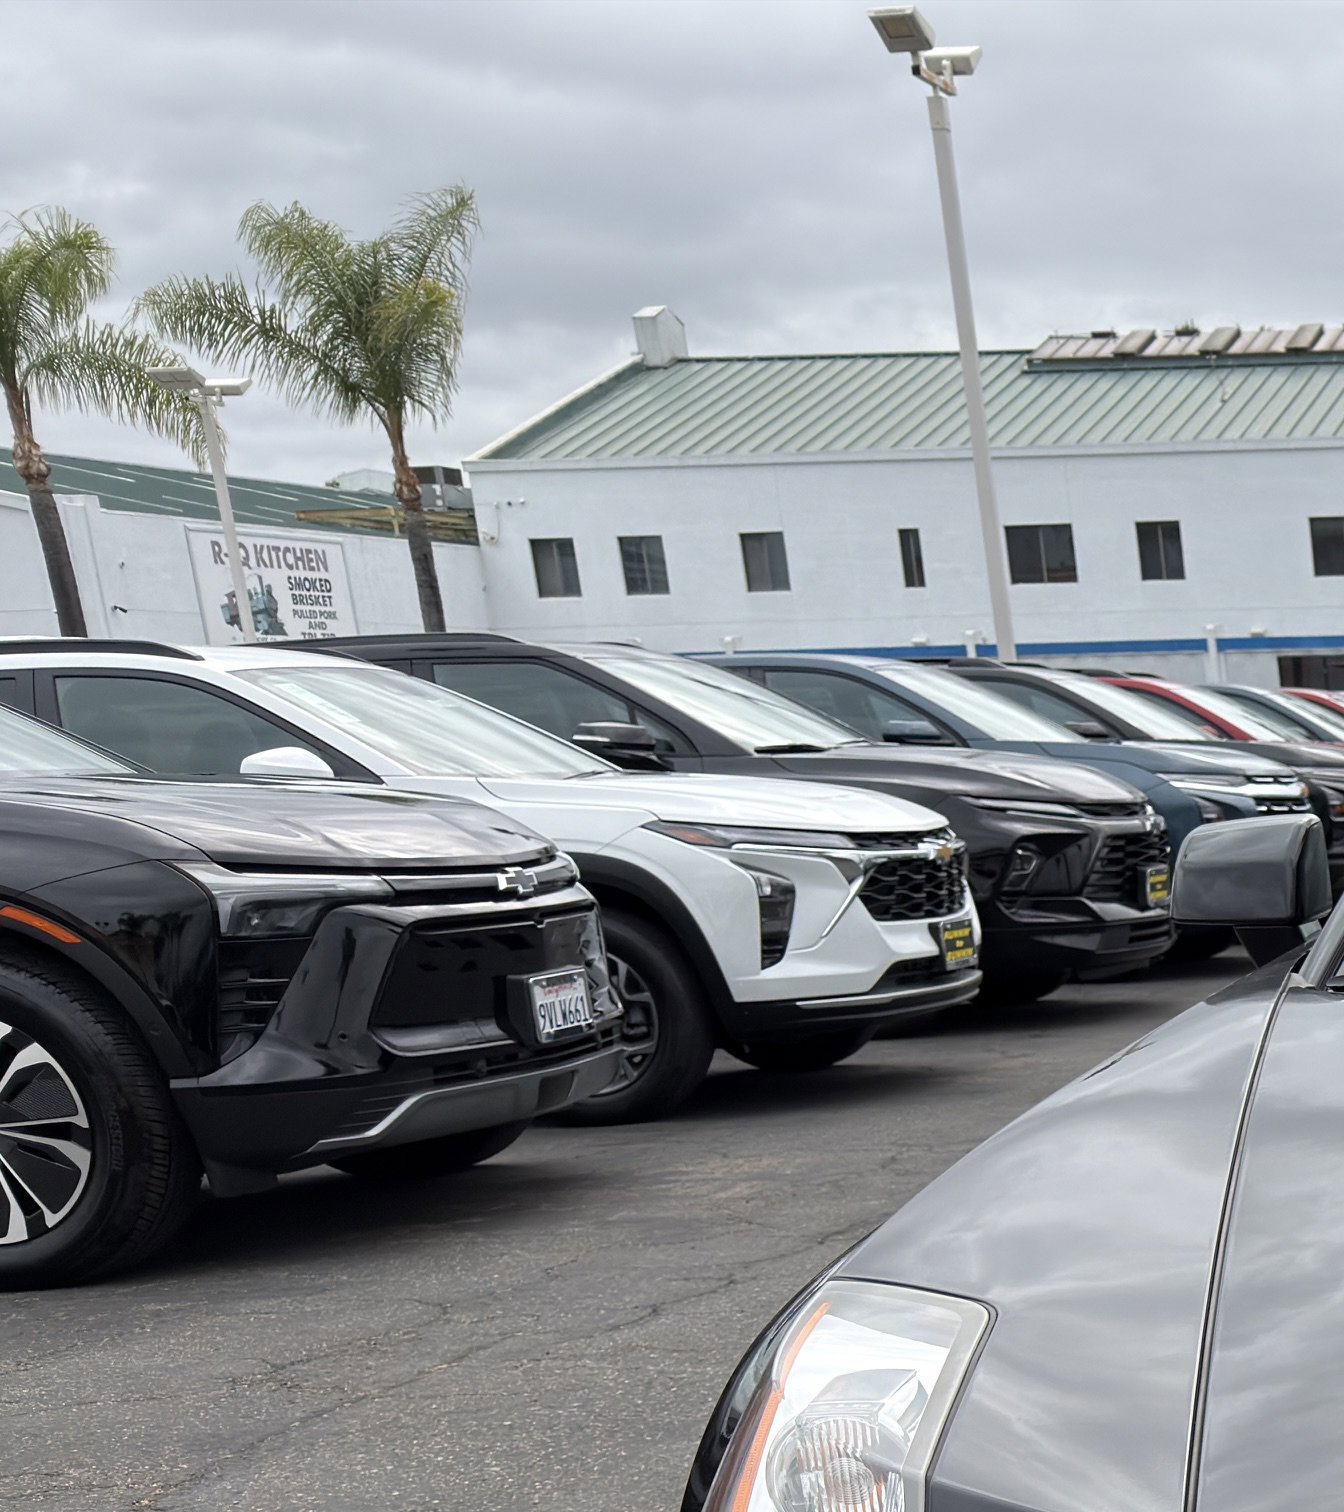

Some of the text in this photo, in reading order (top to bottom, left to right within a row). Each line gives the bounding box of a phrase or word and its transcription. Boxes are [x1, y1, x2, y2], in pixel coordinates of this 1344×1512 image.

[252, 542, 329, 573] KITCHEN
[287, 575, 332, 593] SMOKED
[291, 593, 333, 607] BRISKET
[292, 608, 338, 620] PULLED PORK
[308, 620, 328, 631] AND
